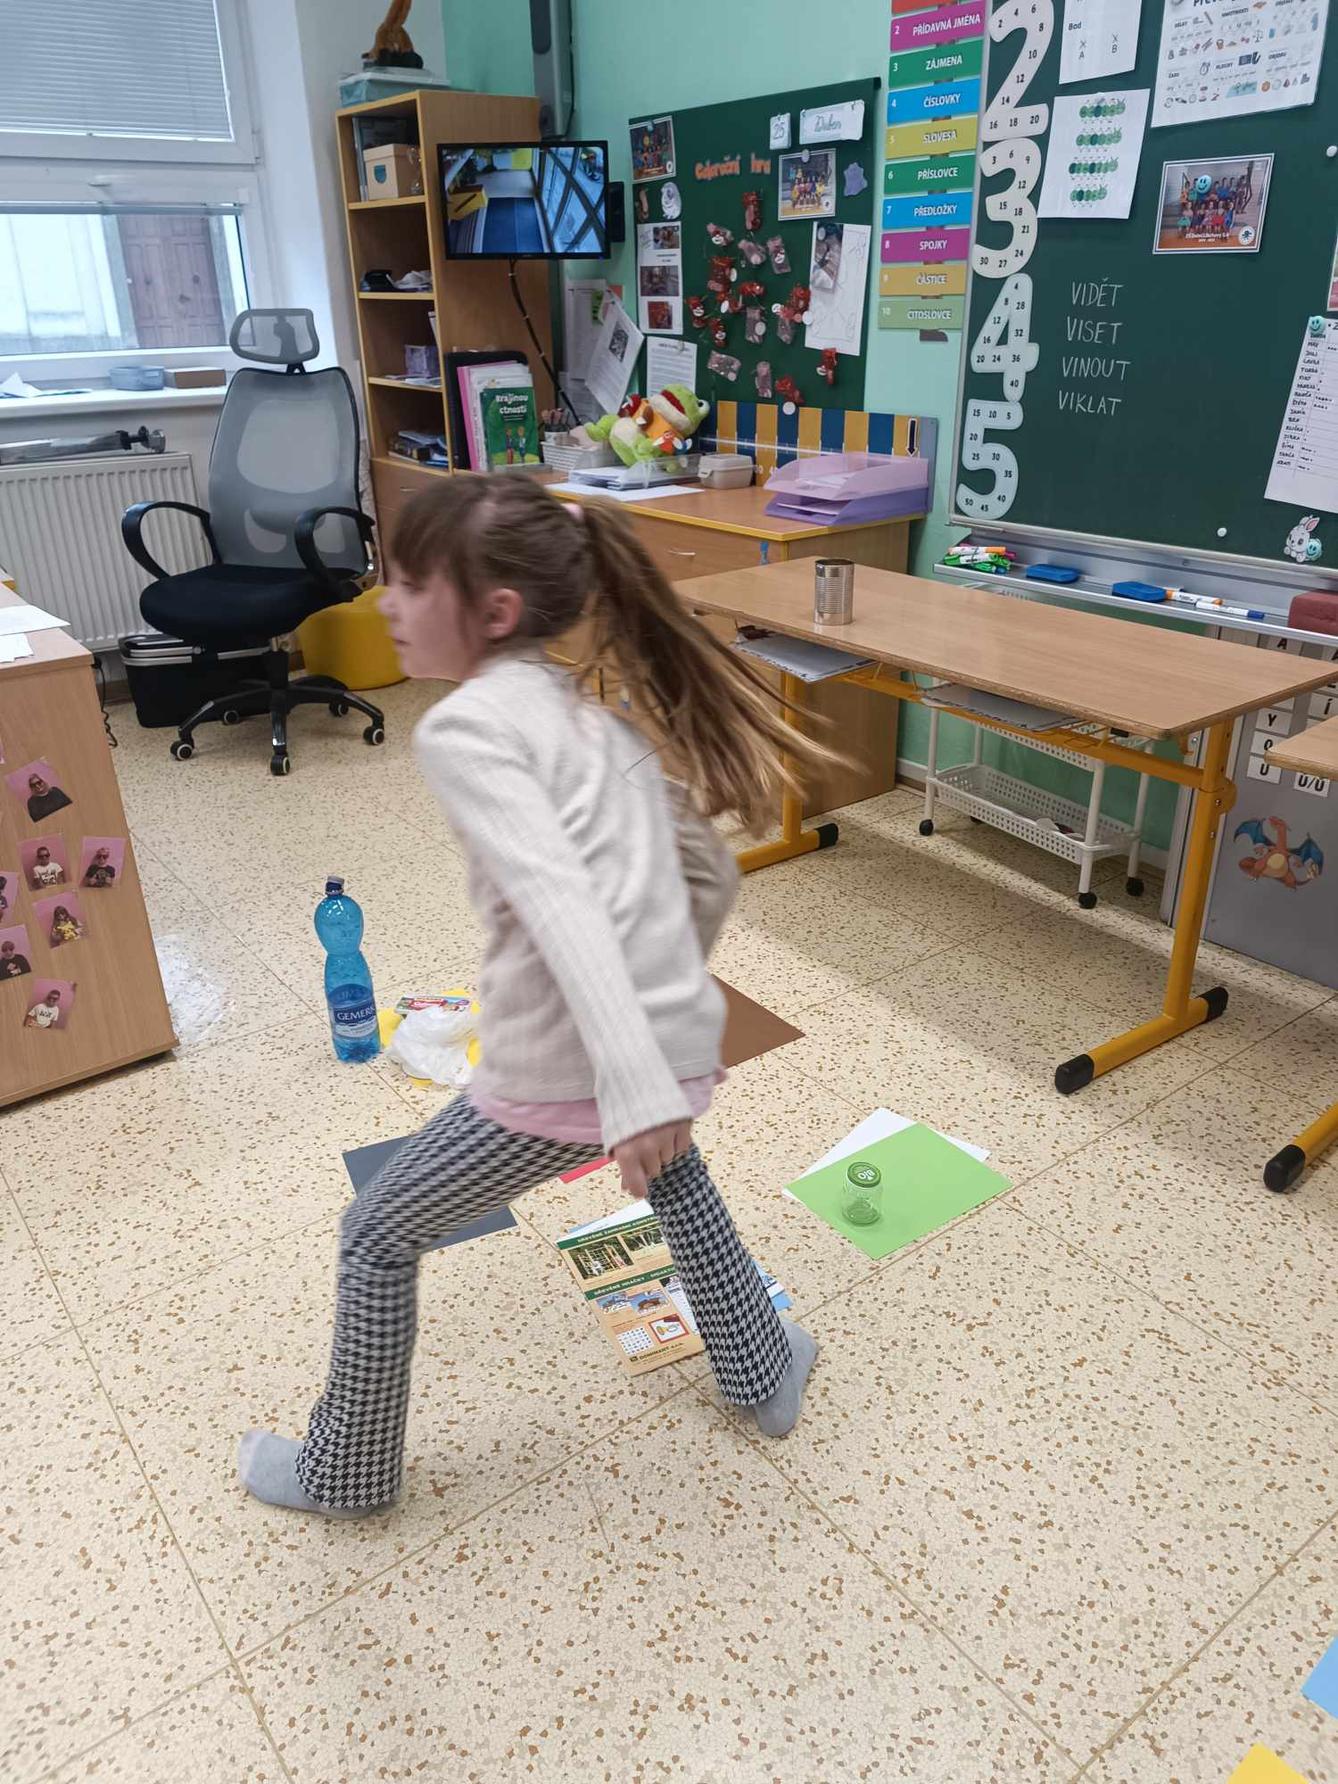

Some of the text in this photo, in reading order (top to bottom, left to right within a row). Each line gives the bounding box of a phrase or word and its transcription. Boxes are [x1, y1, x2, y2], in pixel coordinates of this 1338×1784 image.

[1014, 8, 1019, 16] 4
[1031, 4, 1036, 13] 6
[894, 14, 981, 36] 2 PŘÍDAVNÁ JMÉNA
[998, 19, 1003, 28] 2
[1039, 22, 1044, 32] 8
[1068, 21, 1082, 31] Bod
[1028, 49, 1037, 59] 10
[893, 55, 962, 72] 3 ZÁJMENA
[1016, 74, 1025, 83] 12
[891, 93, 961, 108] 4 ČÍSLOVKY
[1001, 96, 1010, 105] 14
[989, 115, 1039, 129] 16 18 20
[923, 130, 957, 144] SLOVESA
[1009, 149, 1014, 159] 6
[992, 156, 997, 165] 3
[1025, 155, 1031, 164] 9
[888, 167, 959, 181] 6 PŘÍSLOVCE
[1018, 181, 1026, 189] 12
[886, 203, 958, 217] 7 PŘEDLOŽKY
[999, 201, 1008, 210] 15
[1014, 208, 1023, 216] 18
[1021, 225, 1030, 234] 21
[919, 240, 948, 251] SPOJKY
[1015, 249, 1024, 258] 24
[980, 257, 1008, 268] 30 27
[916, 273, 947, 285] ČÁSTICE
[1014, 282, 1019, 290] 4
[1071, 277, 1124, 307] VIDĚT
[1004, 297, 1009, 306] 8
[1016, 301, 1025, 310] 28
[907, 309, 952, 320] CITOSLOVCE
[993, 316, 1001, 324] 12
[1014, 329, 1024, 337] 32
[1066, 315, 1123, 344] VISET
[983, 336, 991, 344] 16
[976, 354, 1021, 363] 20 24 36
[1062, 356, 1131, 381] VINOUT
[1010, 379, 1019, 388] 40
[1058, 389, 1122, 416] VIKLAT
[973, 408, 1011, 420] 15 10 5
[969, 433, 978, 441] 20
[972, 452, 1000, 461] 25 30
[1004, 470, 1012, 479] 35
[965, 498, 974, 506] 50
[997, 495, 1006, 503] 40
[981, 504, 989, 512] 45
[1277, 638, 1288, 650] A
[1267, 713, 1277, 727] Y
